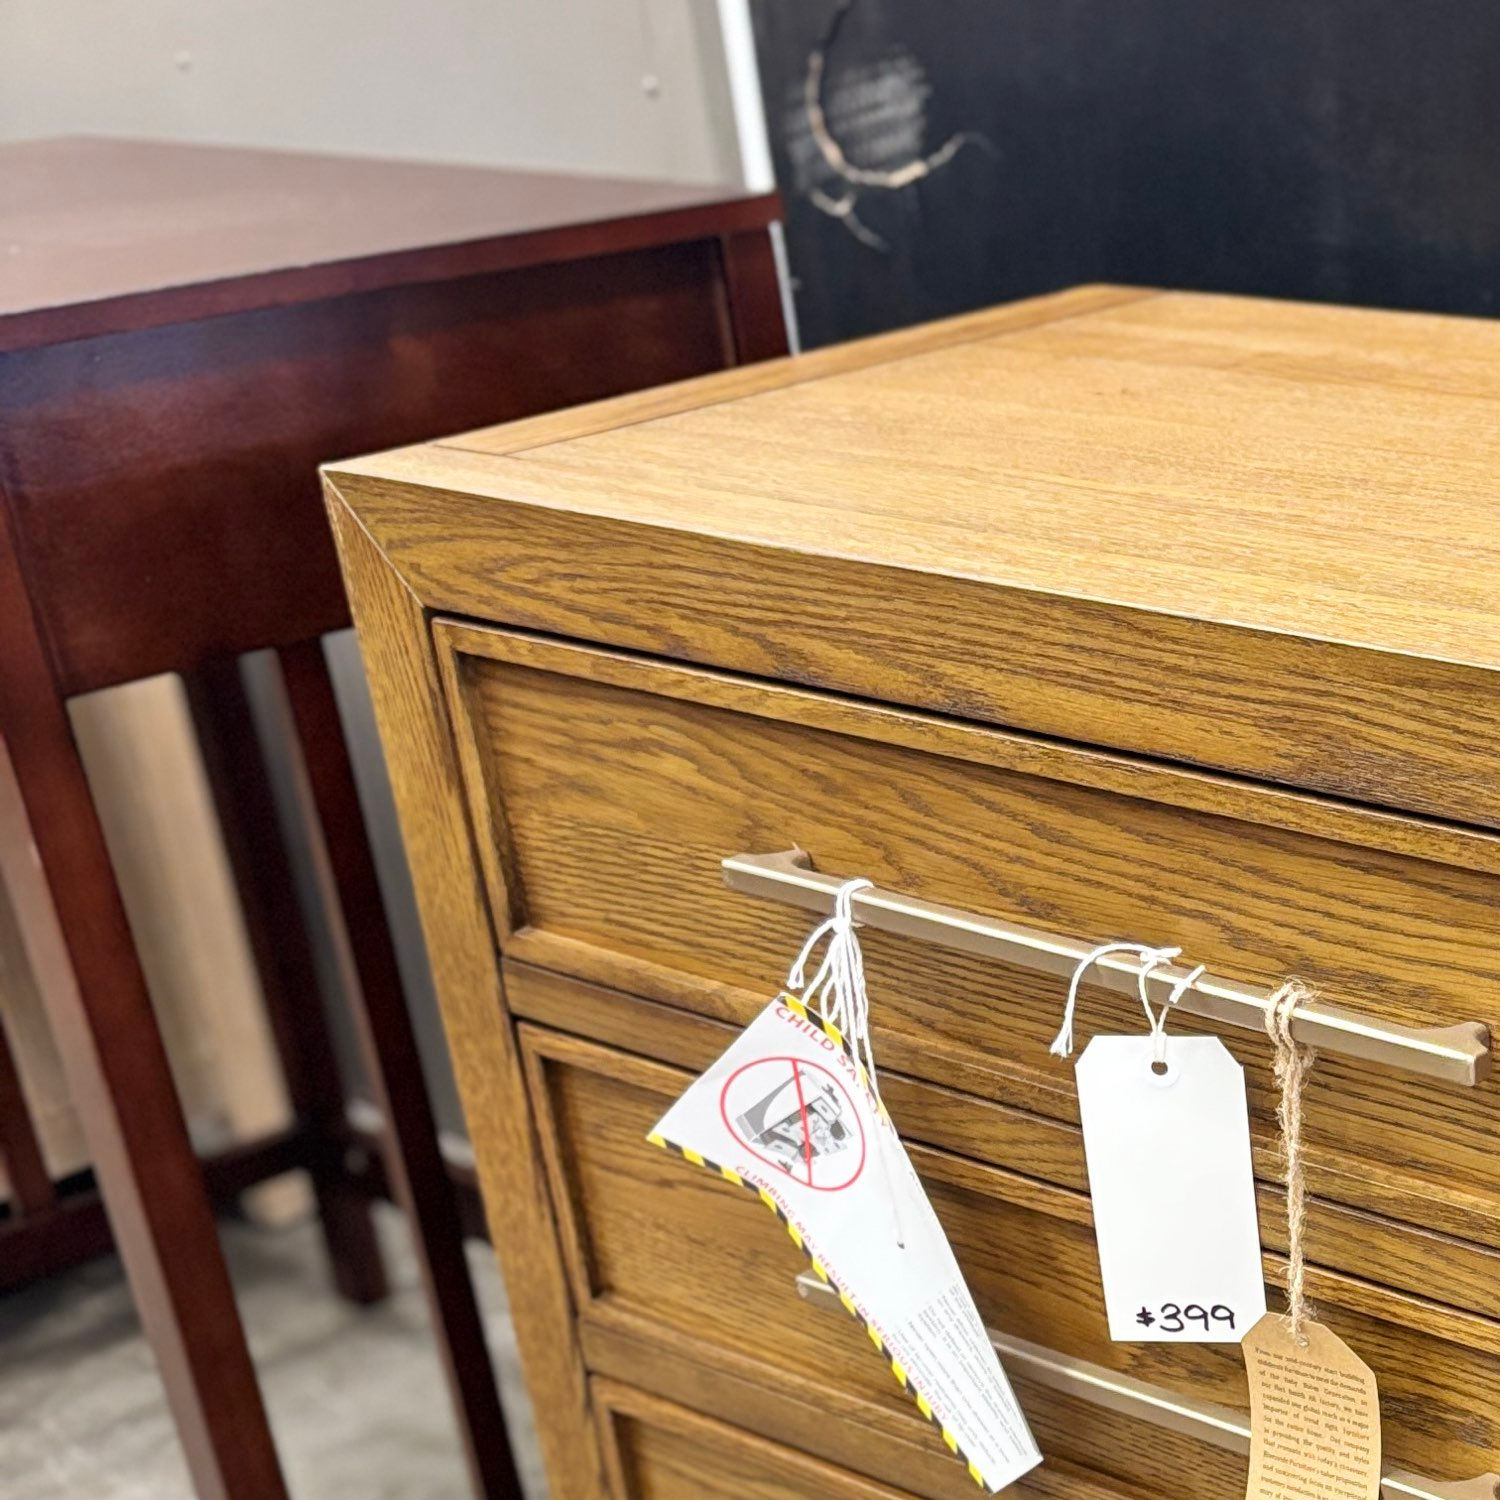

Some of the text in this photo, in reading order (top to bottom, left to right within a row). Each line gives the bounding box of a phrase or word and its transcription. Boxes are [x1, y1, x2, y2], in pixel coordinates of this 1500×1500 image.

[775, 1006, 889, 1128] CHILD SAY
[736, 1166, 796, 1218] CLIMBING
[795, 1221, 816, 1249] MAY
[818, 1254, 856, 1299] RESULT
[871, 1319, 913, 1373] SERIOUS
[913, 1376, 947, 1421] INJURY
[1136, 1303, 1235, 1332] $399
